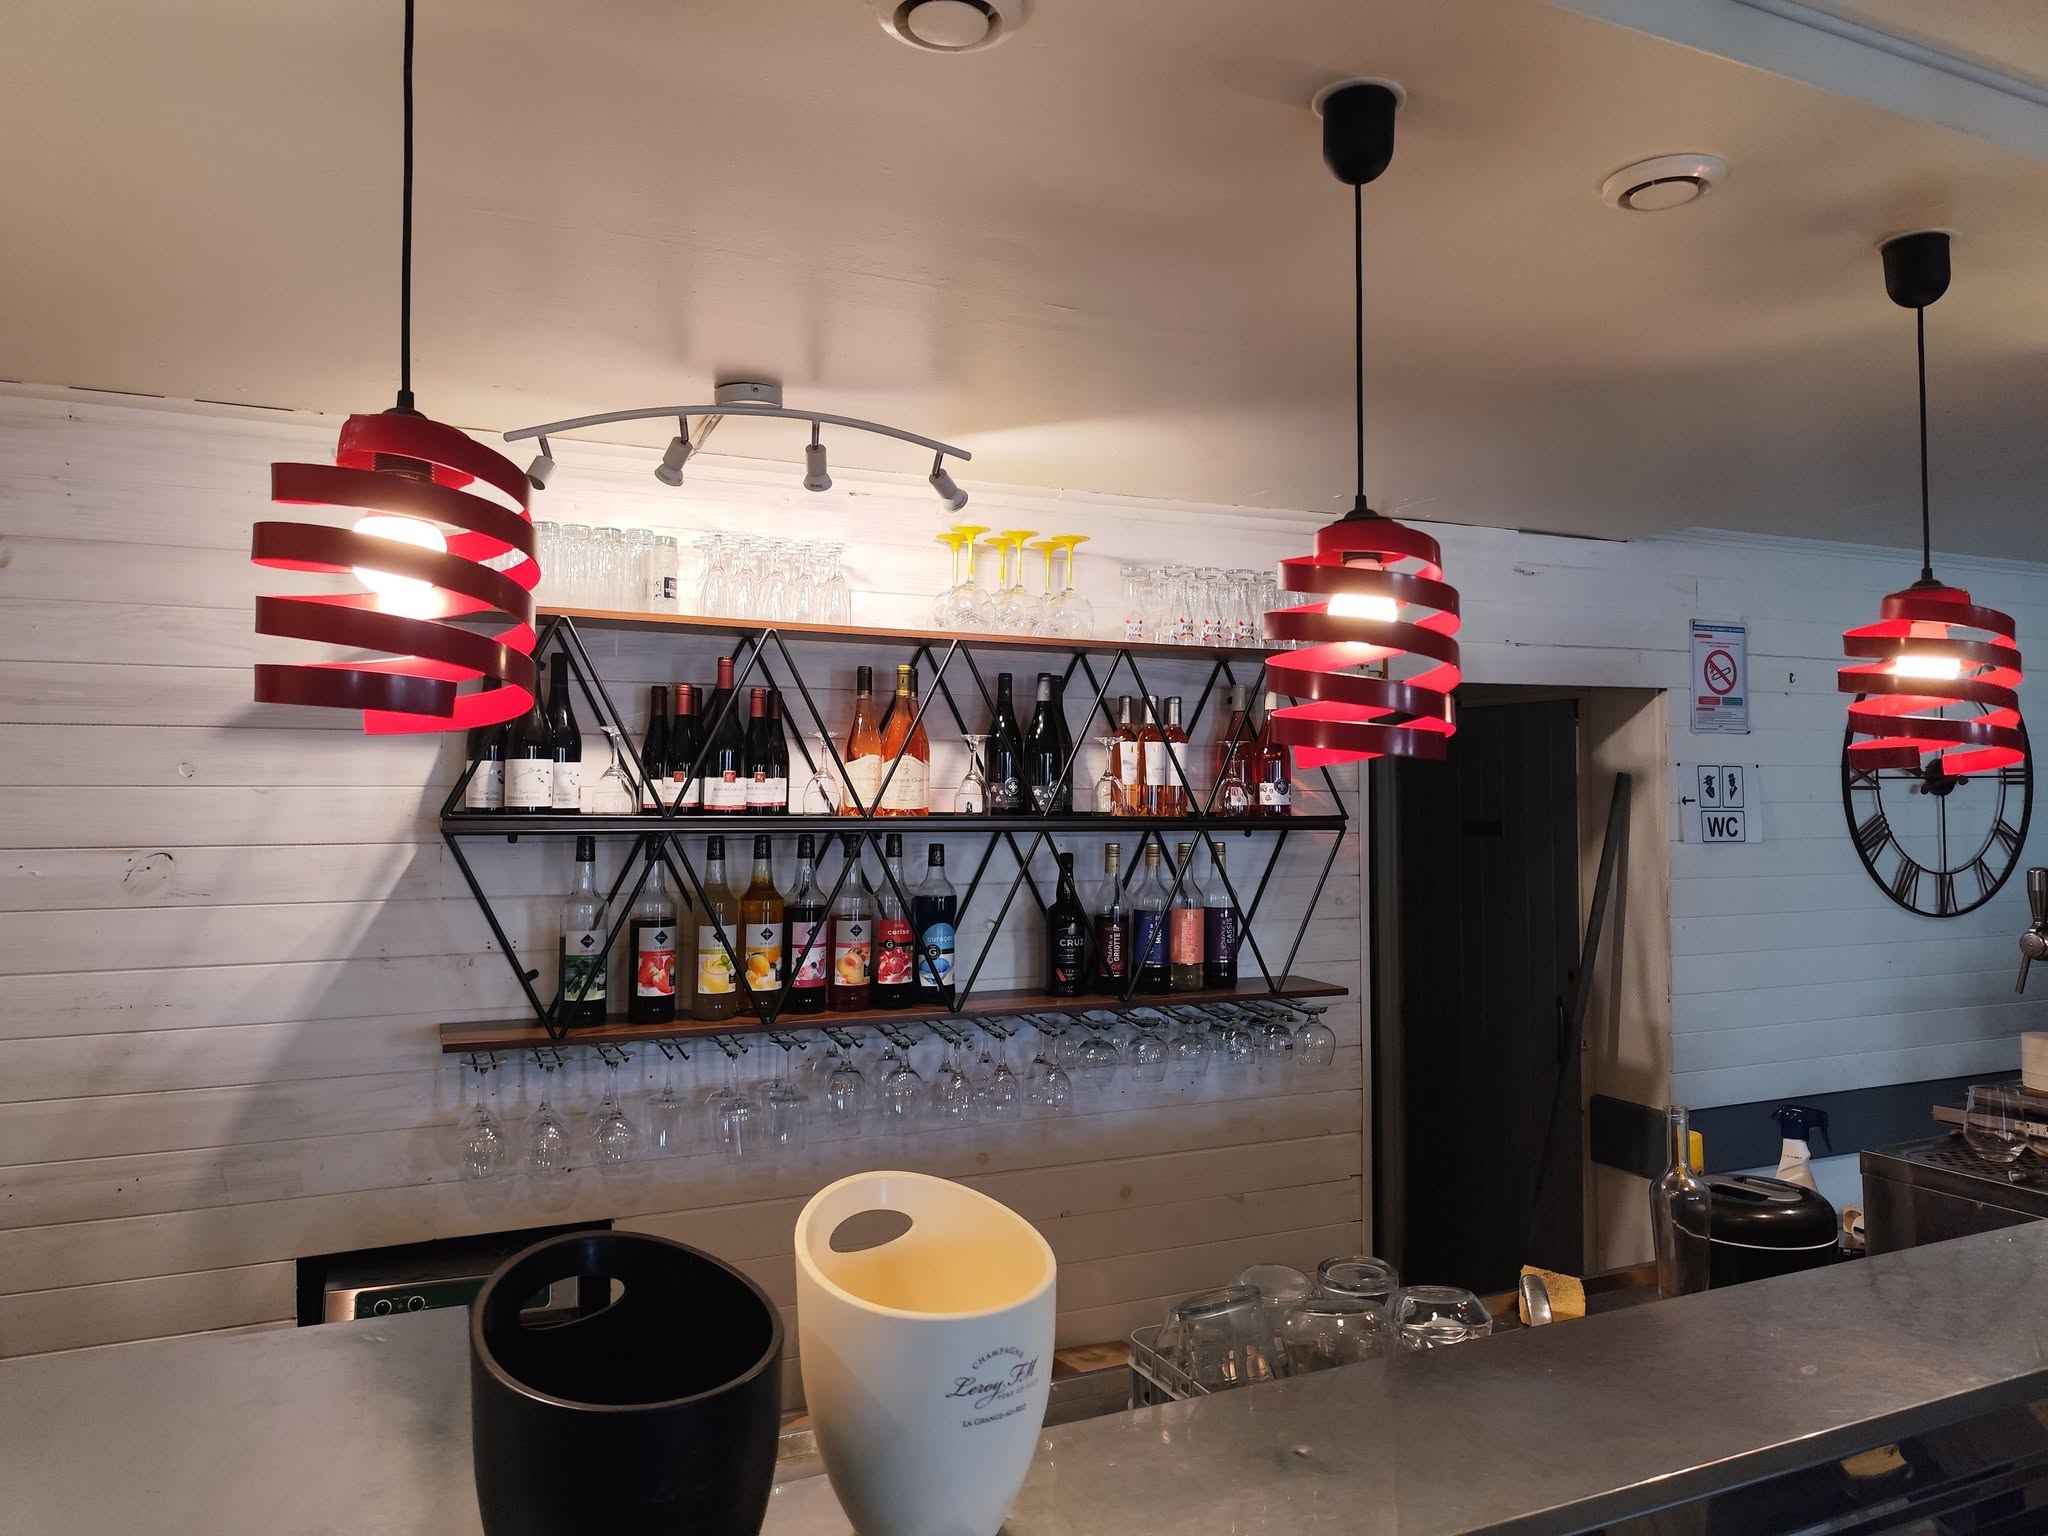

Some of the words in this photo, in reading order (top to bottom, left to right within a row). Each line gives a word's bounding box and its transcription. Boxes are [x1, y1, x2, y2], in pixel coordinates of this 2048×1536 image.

[1707, 816, 1739, 838] WC
[1113, 932, 1121, 962] GRIOTTE
[972, 1346, 1024, 1370] CHAMPAGNE
[945, 1377, 1004, 1410] Leroy
